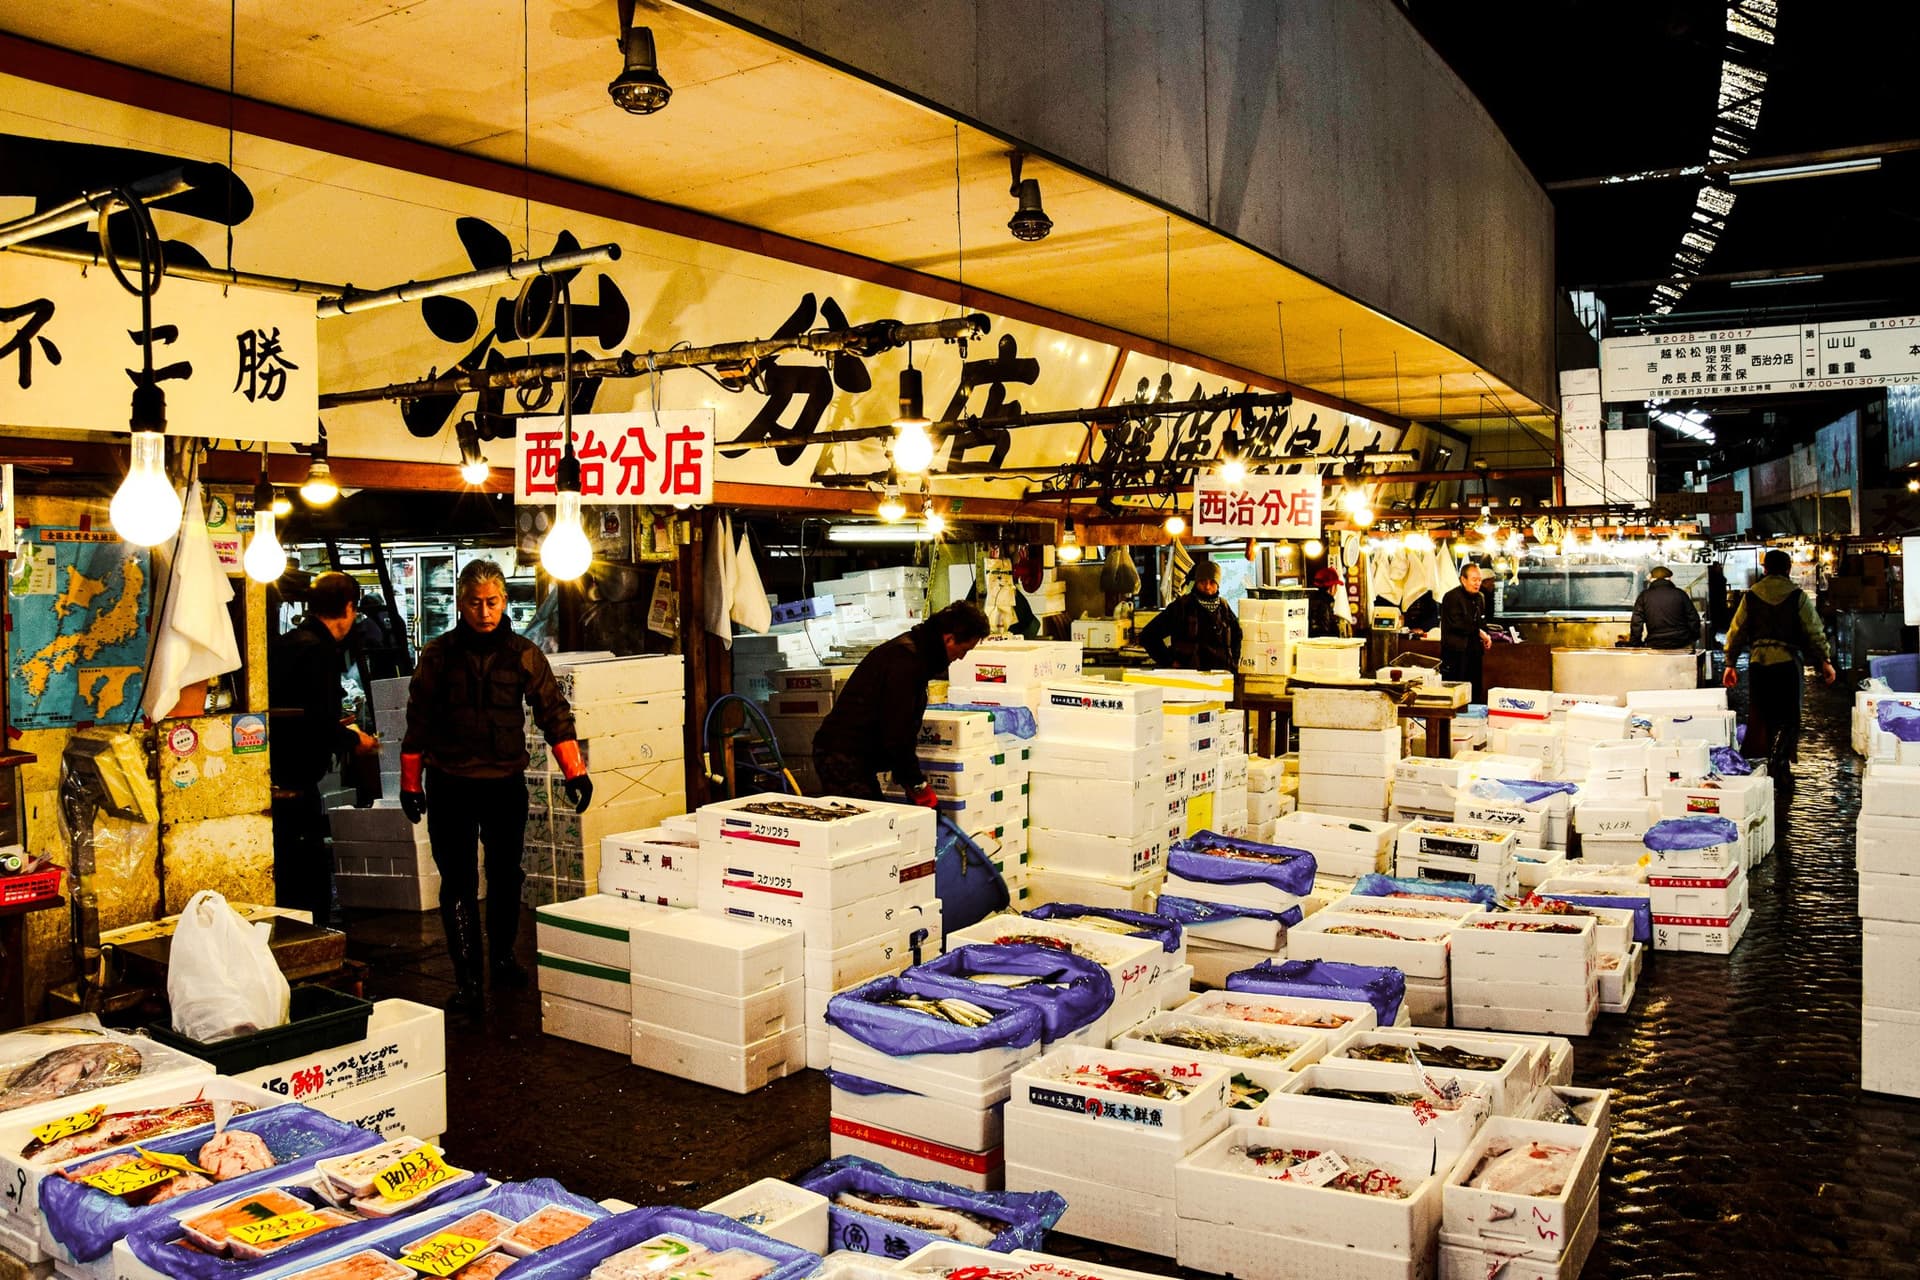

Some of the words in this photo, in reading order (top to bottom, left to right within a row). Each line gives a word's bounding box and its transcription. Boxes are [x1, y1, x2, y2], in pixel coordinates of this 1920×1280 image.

[1705, 345, 1718, 382] 明定水産
[1720, 344, 1733, 381] 明定水産
[1751, 353, 1794, 367] 西治分店
[524, 424, 706, 498] 西治分店
[1199, 487, 1316, 528] 西治分店
[1103, 1102, 1164, 1128] 坂本鮮魚
